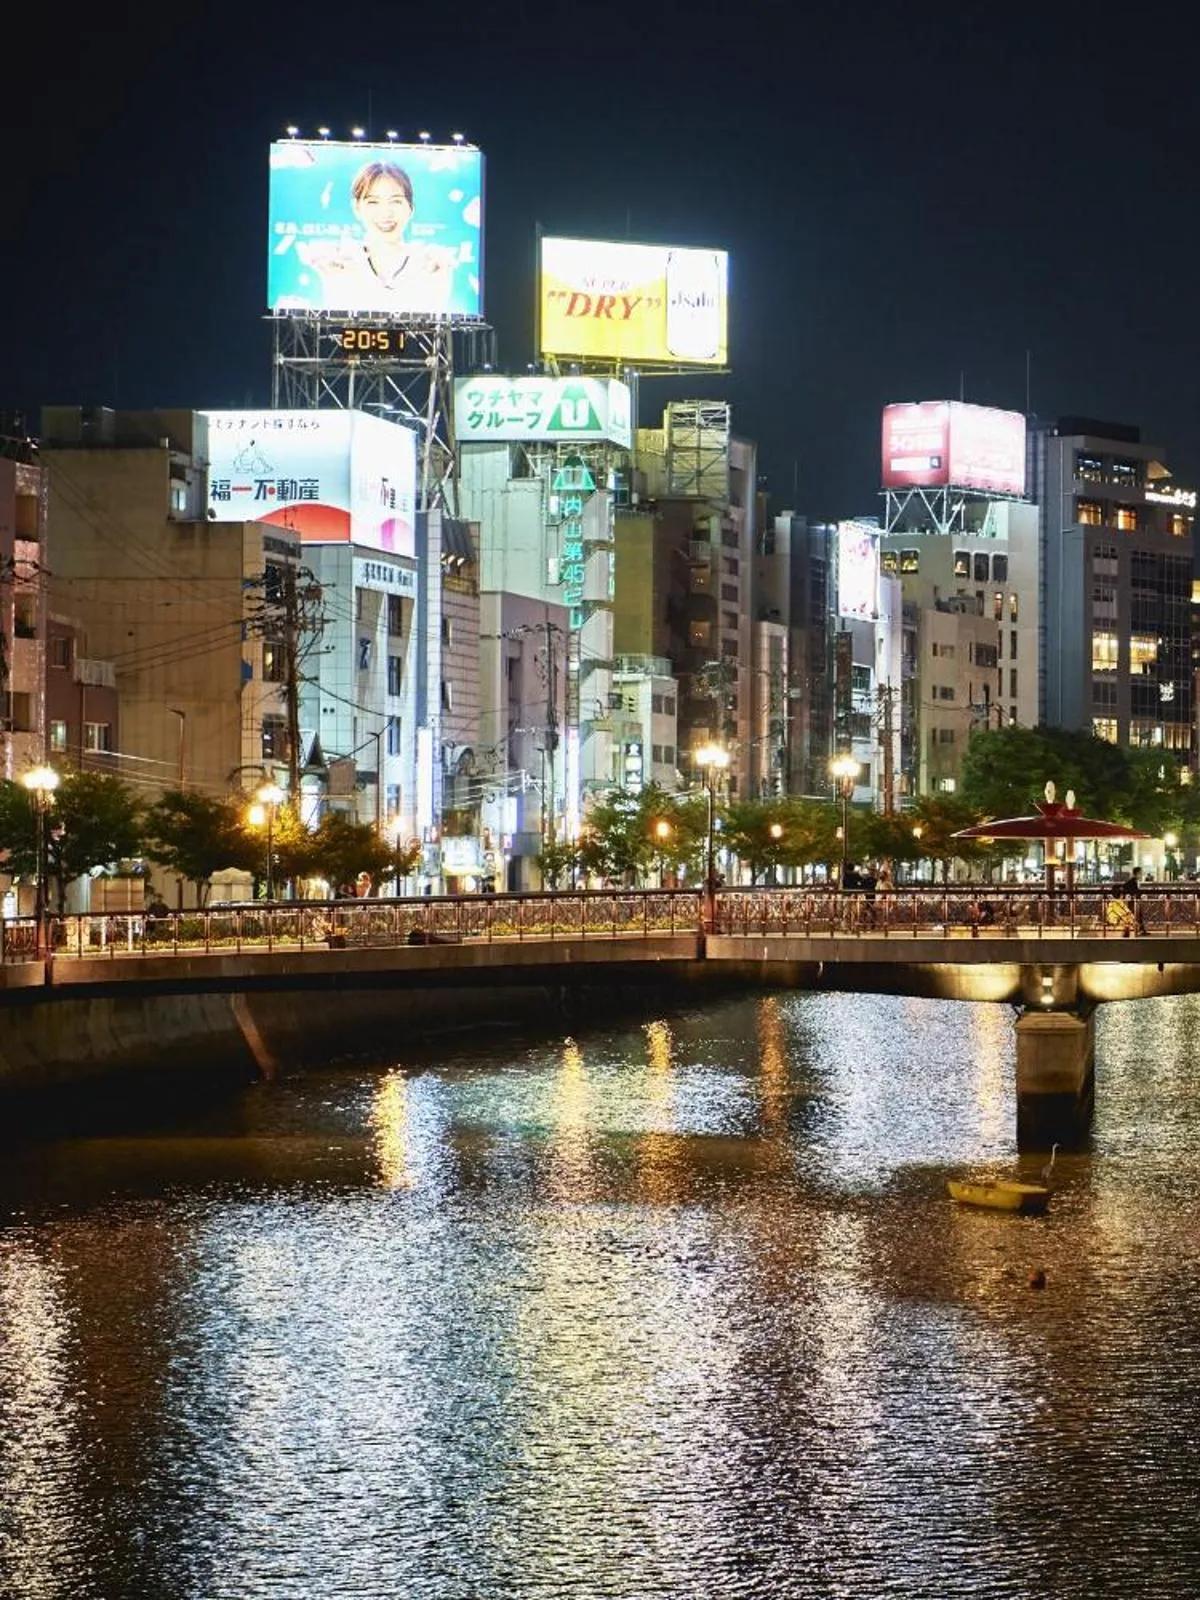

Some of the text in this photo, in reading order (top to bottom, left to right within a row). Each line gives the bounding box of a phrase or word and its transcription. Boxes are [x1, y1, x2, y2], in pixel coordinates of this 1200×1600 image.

[343, 331, 404, 349] 20:51
[467, 389, 544, 407] ウチヤマ
[210, 478, 319, 501] 福一不動産
